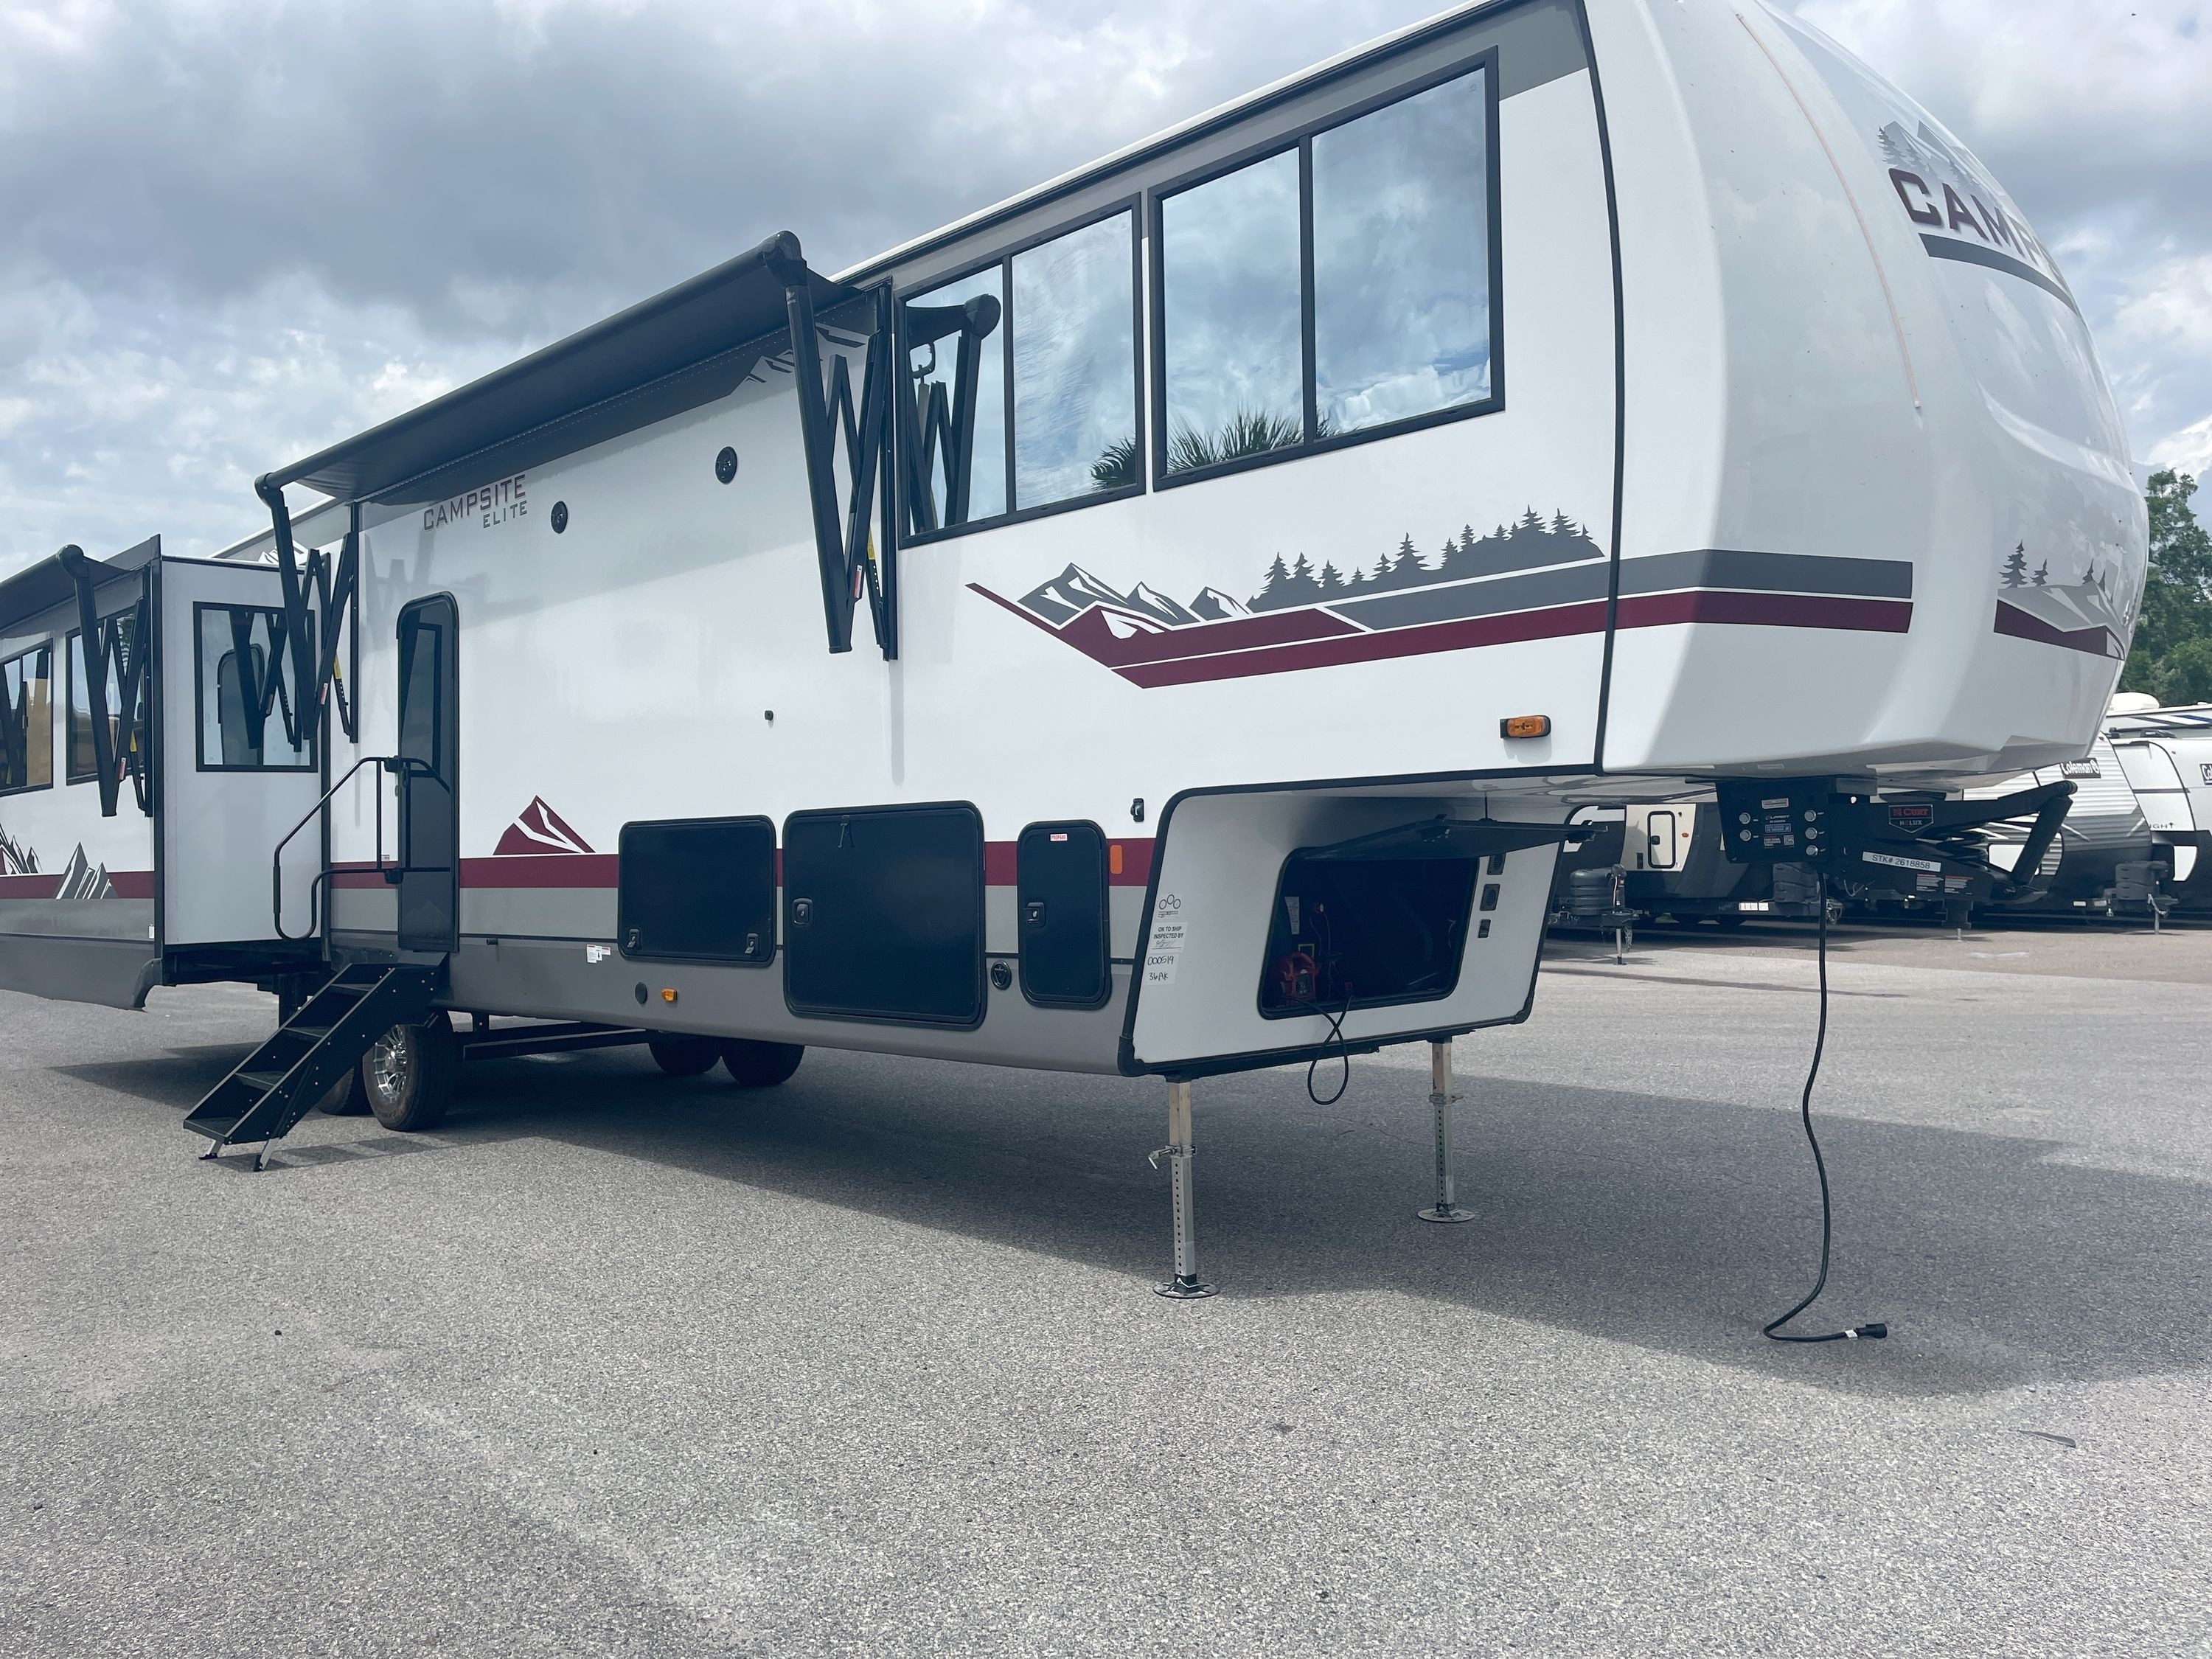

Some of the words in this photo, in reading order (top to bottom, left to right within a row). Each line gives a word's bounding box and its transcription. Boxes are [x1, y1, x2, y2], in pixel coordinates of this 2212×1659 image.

[424, 474, 526, 530] CAMPSITE
[483, 501, 527, 528] ELITE
[1872, 854, 1893, 864] STK#
[1895, 858, 1930, 869] 2618858
[1147, 955, 1175, 966] 000519
